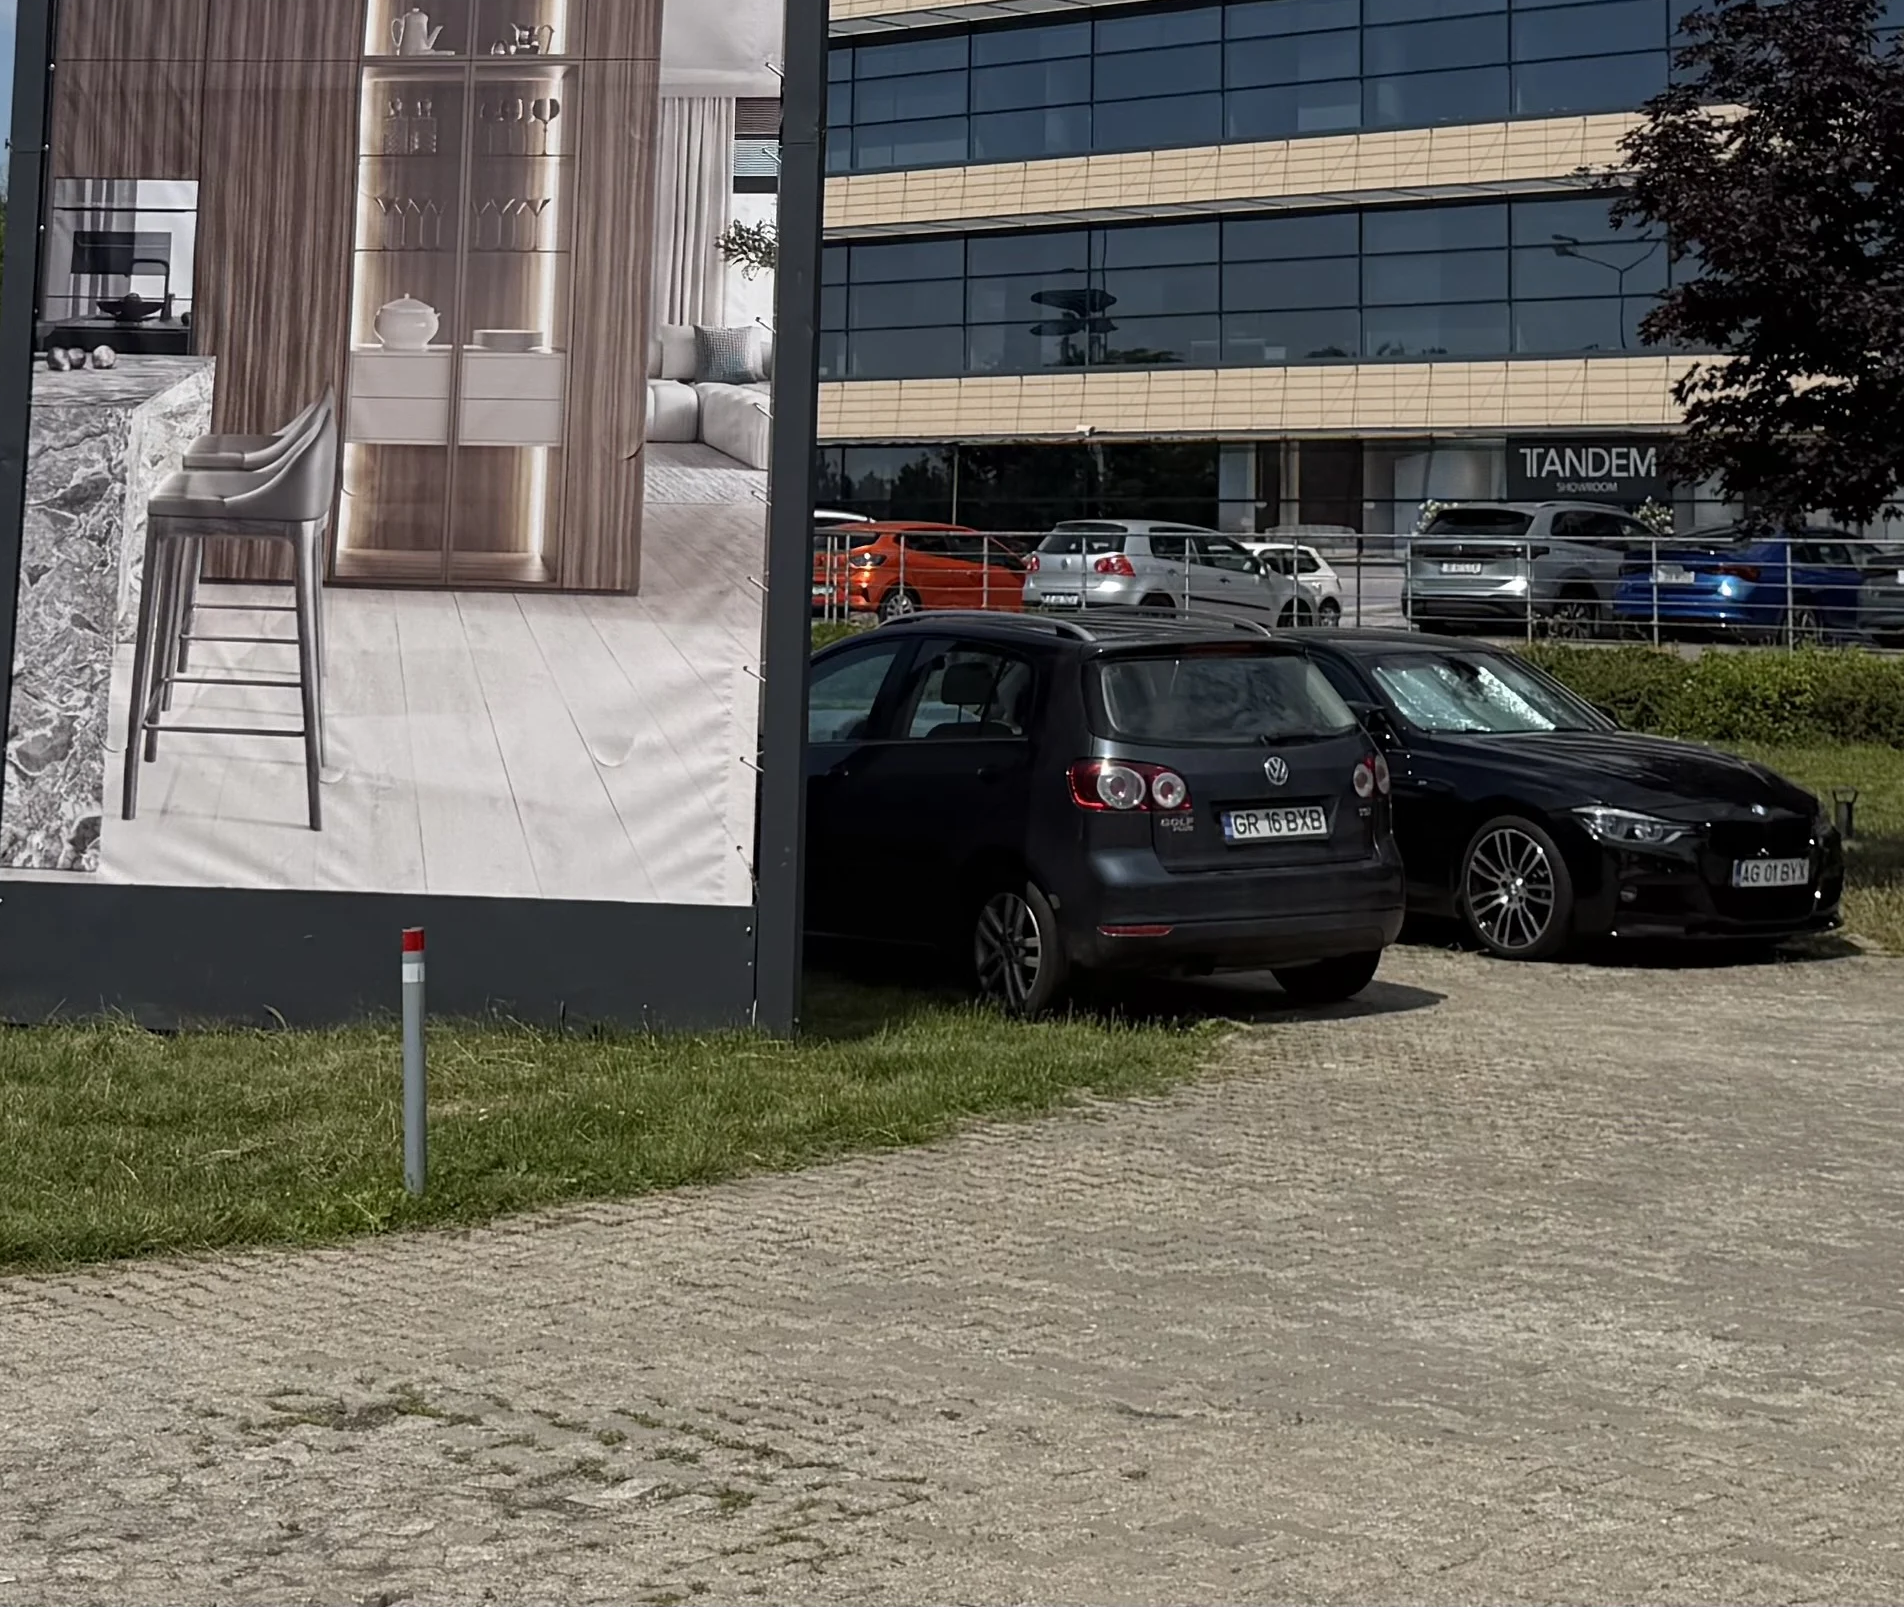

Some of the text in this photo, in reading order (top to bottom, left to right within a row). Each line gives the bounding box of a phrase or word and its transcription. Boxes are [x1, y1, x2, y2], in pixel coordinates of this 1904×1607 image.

[1519, 447, 1657, 478] TANDEM
[1556, 481, 1618, 493] SHOWROOM
[1233, 809, 1323, 835] GR 16 BXB
[1742, 864, 1761, 883] AG
[1764, 863, 1778, 883] 01
